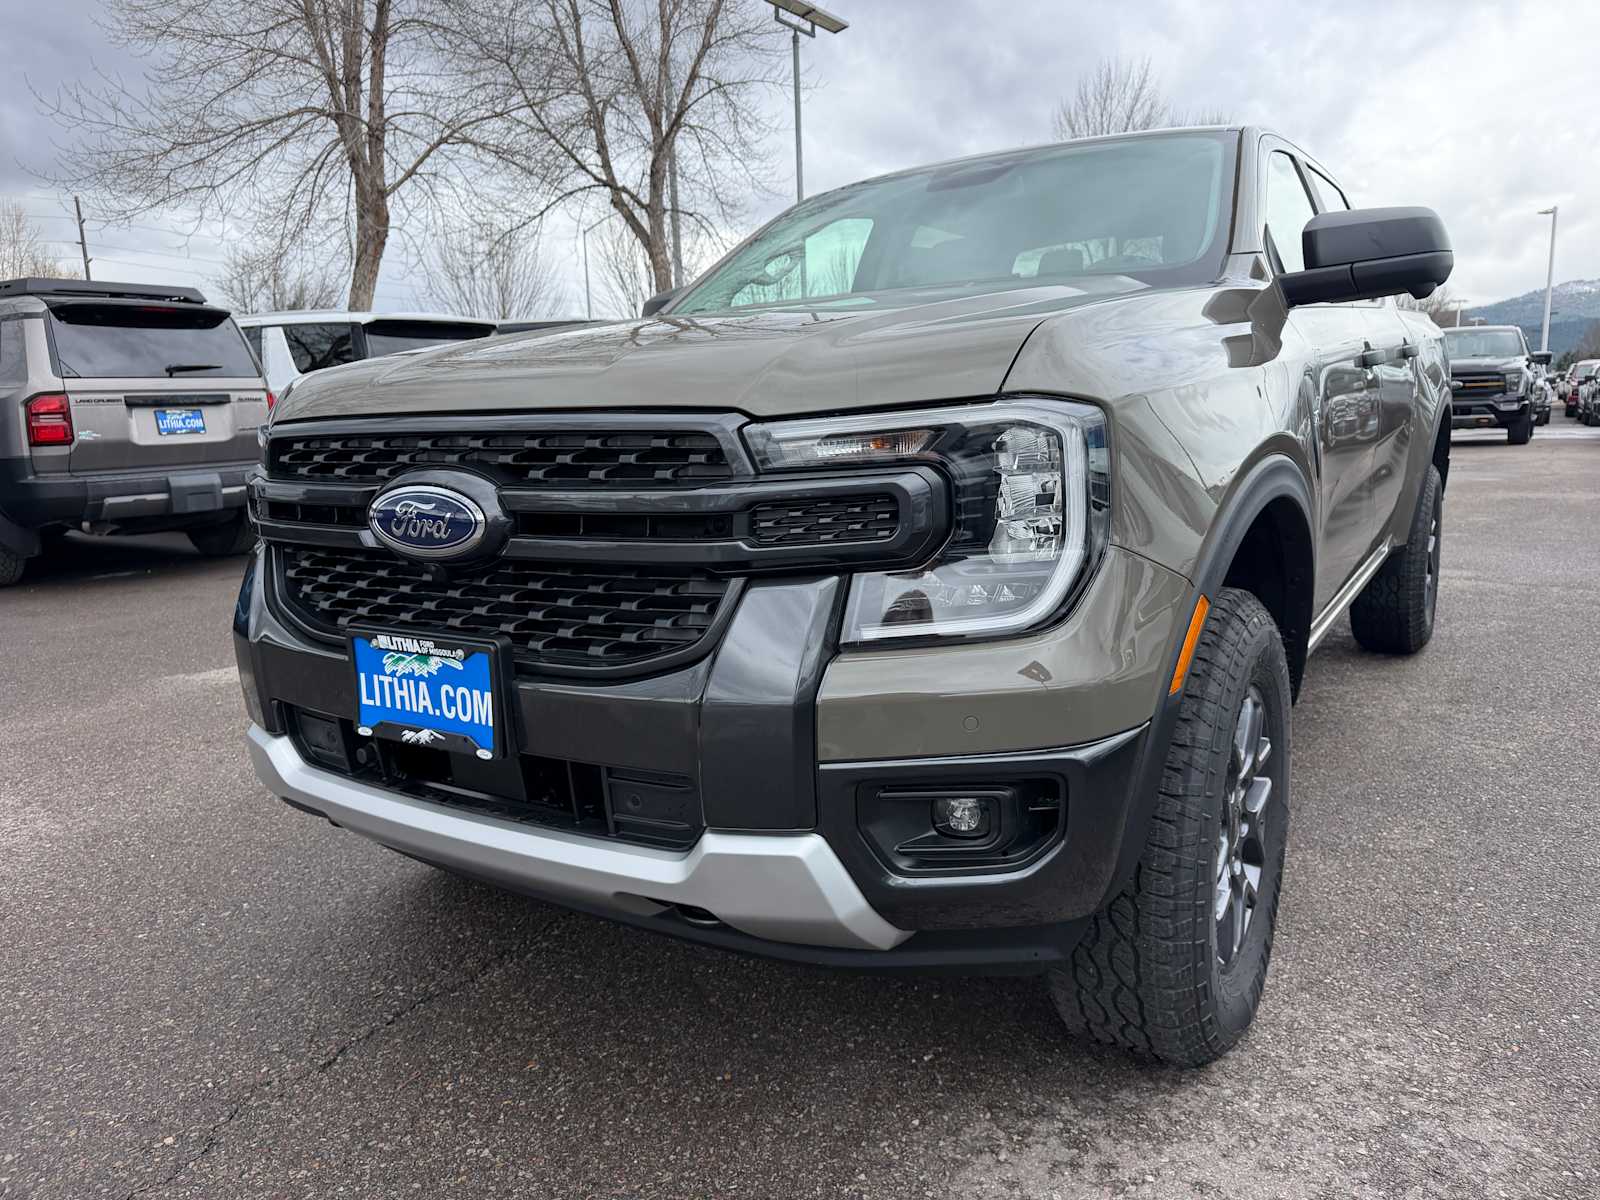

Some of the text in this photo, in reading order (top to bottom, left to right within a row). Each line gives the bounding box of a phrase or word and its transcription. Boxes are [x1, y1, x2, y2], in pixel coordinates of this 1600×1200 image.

[159, 418, 203, 429] LITHIA.COM
[390, 500, 452, 540] Ford
[388, 635, 421, 654] LITHIA
[419, 640, 434, 649] FORD
[360, 673, 493, 727] LITHIA.COM
